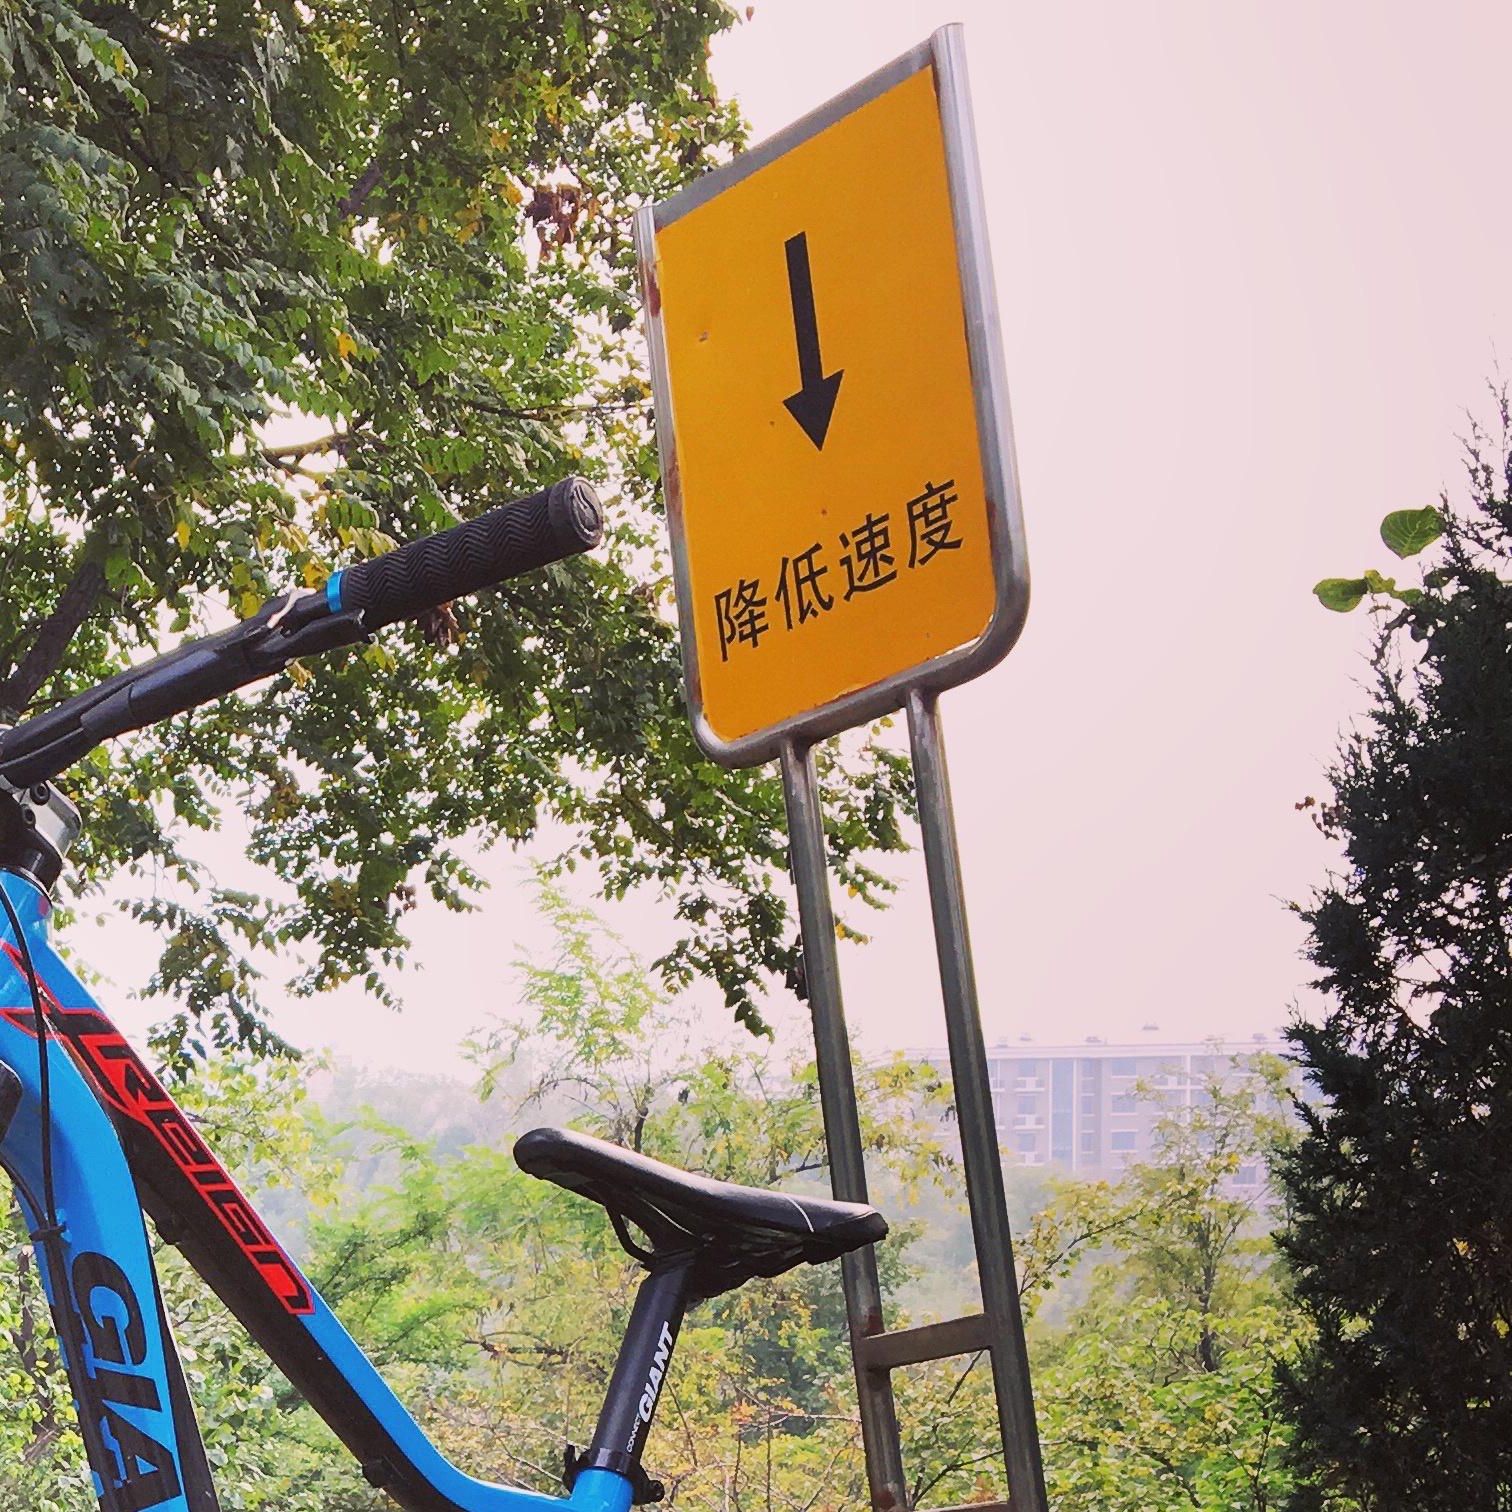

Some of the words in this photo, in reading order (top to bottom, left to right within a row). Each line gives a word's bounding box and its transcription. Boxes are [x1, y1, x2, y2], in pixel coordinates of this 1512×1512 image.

[714, 479, 964, 662] 降低速度
[638, 1320, 675, 1423] GIANT
